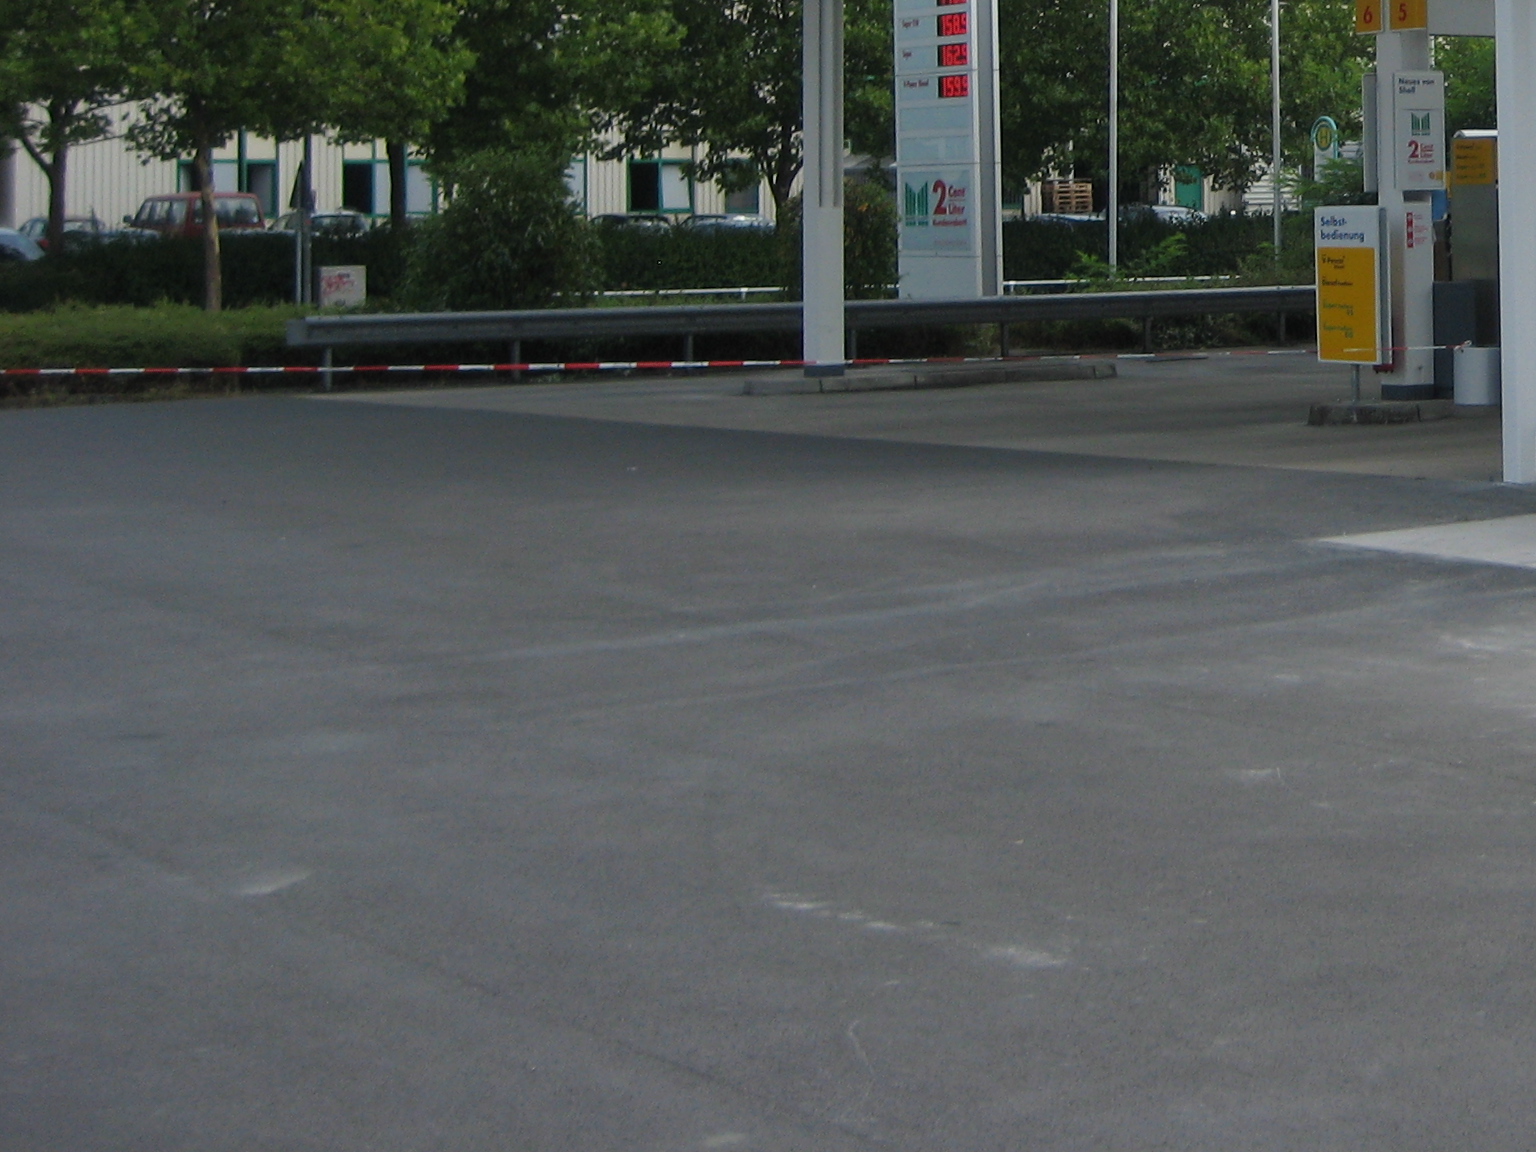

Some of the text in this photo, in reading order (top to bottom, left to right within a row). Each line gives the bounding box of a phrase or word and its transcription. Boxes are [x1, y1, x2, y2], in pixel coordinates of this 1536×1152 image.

[1363, 5, 1373, 24] 6
[1399, 2, 1407, 22] 5
[1408, 139, 1420, 158] 2
[932, 179, 947, 215] 2
[1320, 215, 1347, 227] Selbst-
[1320, 230, 1365, 243] bedienung
